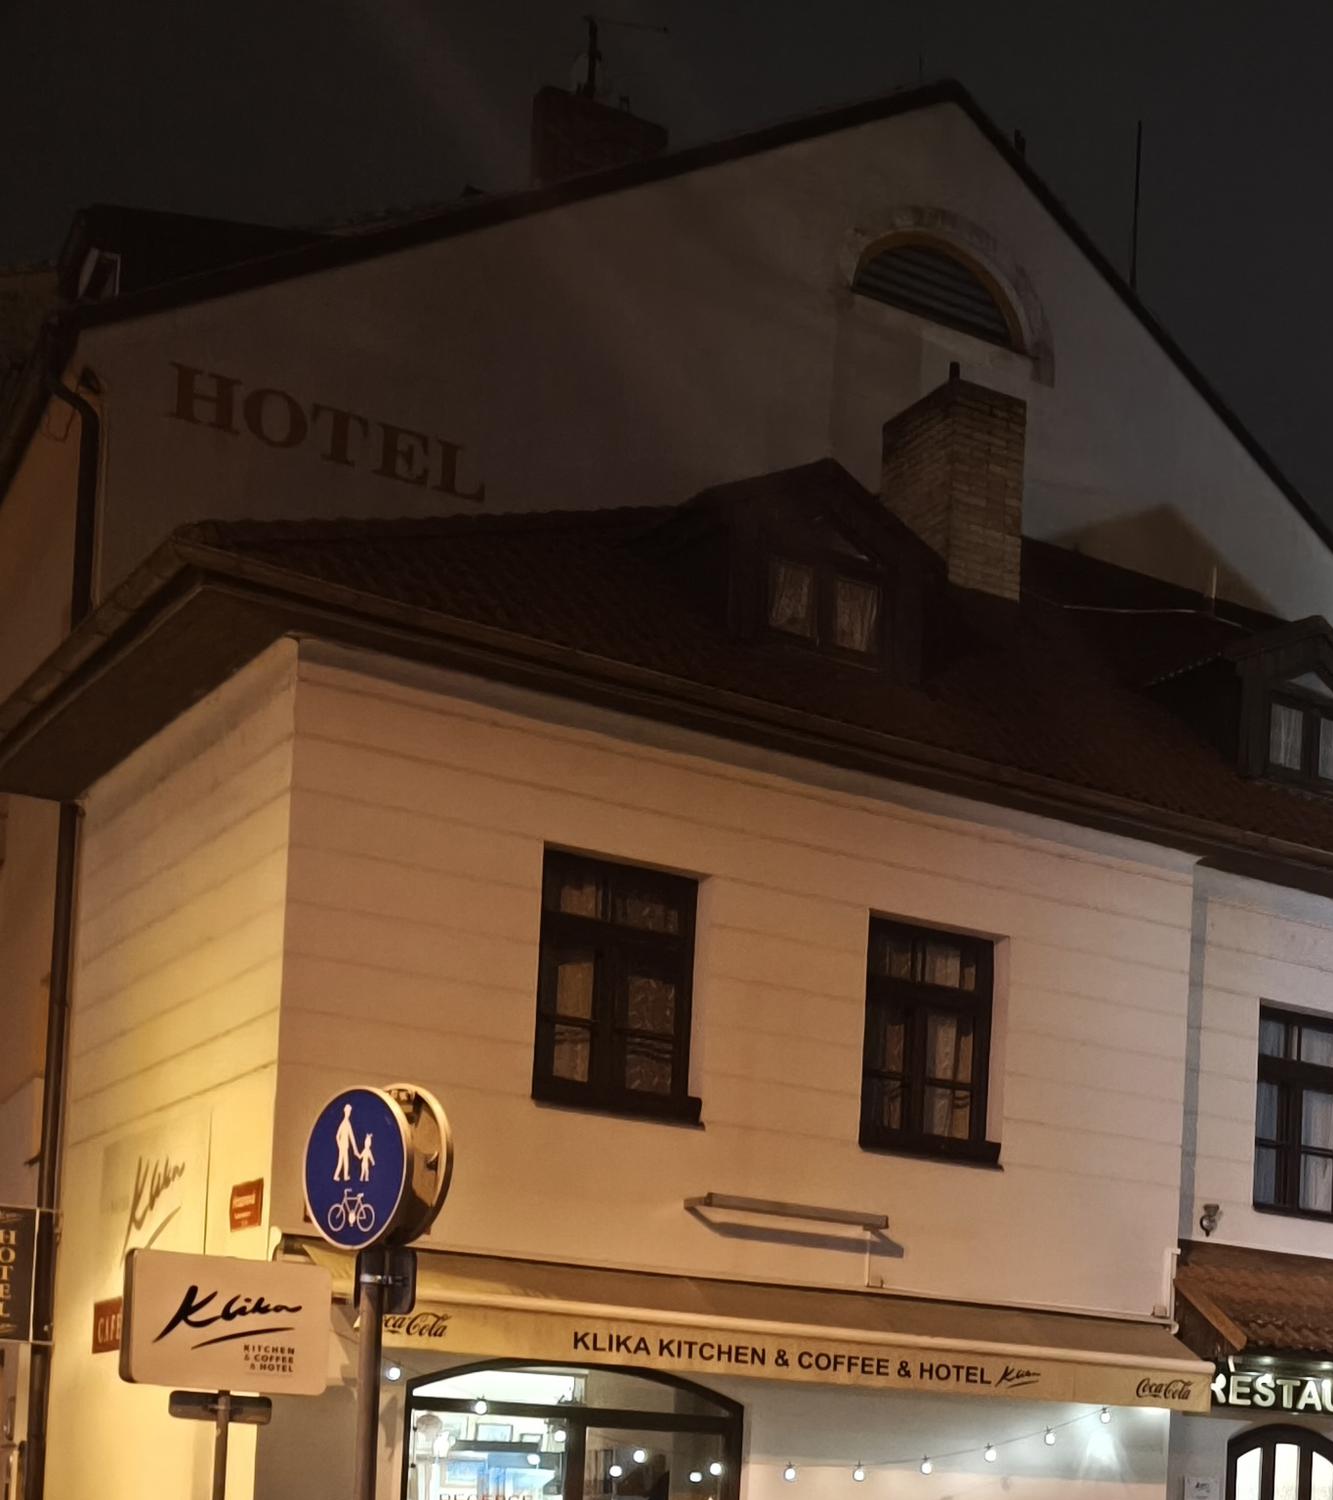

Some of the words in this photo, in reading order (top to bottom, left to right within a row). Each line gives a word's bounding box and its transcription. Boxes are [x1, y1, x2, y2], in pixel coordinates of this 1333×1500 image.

[168, 361, 486, 504] HOTEL
[152, 1285, 302, 1344] Klika
[243, 1344, 295, 1355] KITCHEN
[254, 1353, 294, 1364] COFFEE
[573, 1331, 651, 1356] KLIKA
[659, 1338, 766, 1366] KITCHEN
[774, 1349, 790, 1368] &
[798, 1351, 890, 1377] COFFEE
[897, 1360, 912, 1378] &
[919, 1362, 992, 1385] HOTEL
[260, 1363, 294, 1373] HOTEL
